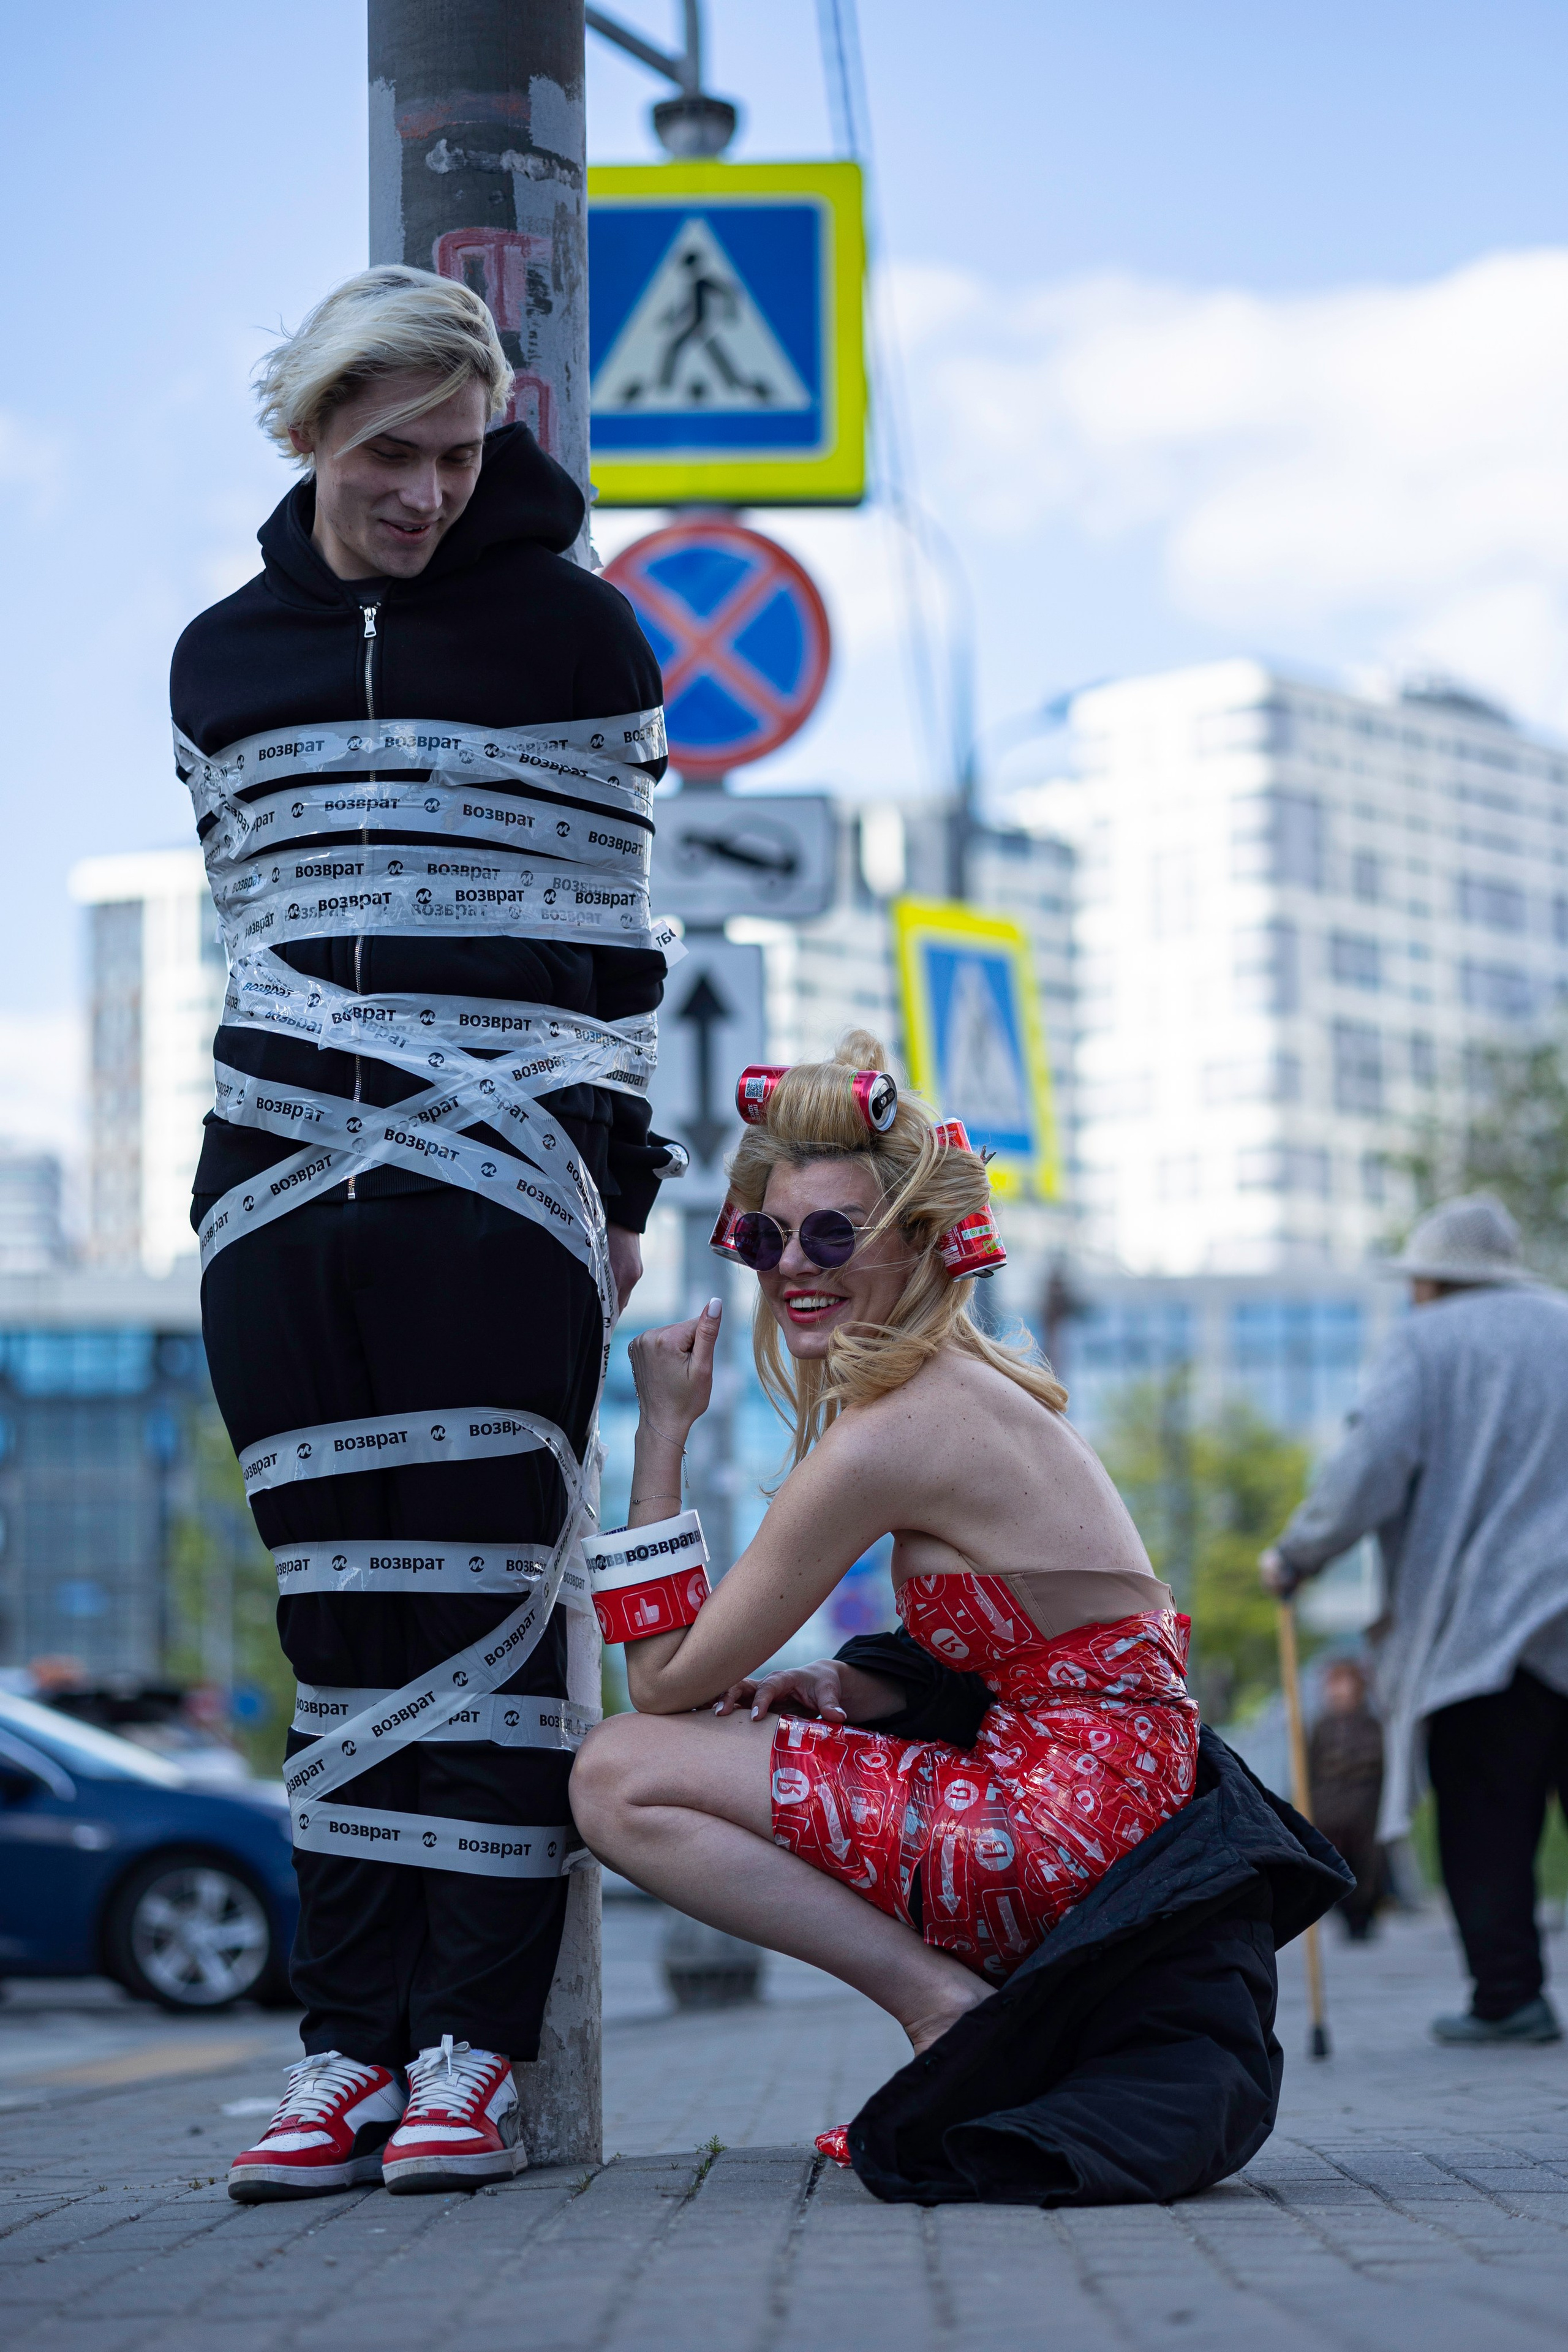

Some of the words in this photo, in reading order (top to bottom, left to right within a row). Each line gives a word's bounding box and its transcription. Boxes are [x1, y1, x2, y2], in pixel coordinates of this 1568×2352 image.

[258, 739, 325, 761] возврат
[385, 735, 462, 752] возврат
[519, 753, 589, 778] возврат
[325, 797, 400, 812] возврат
[462, 804, 536, 828] возврат
[588, 831, 644, 856] возврат
[232, 873, 263, 894] возврат
[295, 862, 364, 879] возврат
[427, 862, 501, 882] возврат
[318, 891, 393, 913] возврат
[455, 889, 524, 905] возврат
[575, 891, 636, 910] возврат
[243, 982, 295, 998] возврат
[459, 1014, 532, 1033] возврат
[256, 1096, 325, 1122] возврат
[383, 1128, 459, 1162] возврат
[516, 1178, 575, 1226] возврат
[201, 1211, 230, 1251] возврат
[270, 1154, 333, 1196] возврат
[334, 1430, 408, 1453] возврат
[369, 1557, 445, 1574] возврат
[625, 1531, 693, 1563] возврат
[563, 1571, 585, 1591] возврат
[483, 1608, 537, 1667] возврат
[296, 1696, 349, 1717] возврат
[371, 1690, 437, 1738] возврат
[329, 1820, 401, 1842] возврат
[458, 1838, 532, 1859] возврат
